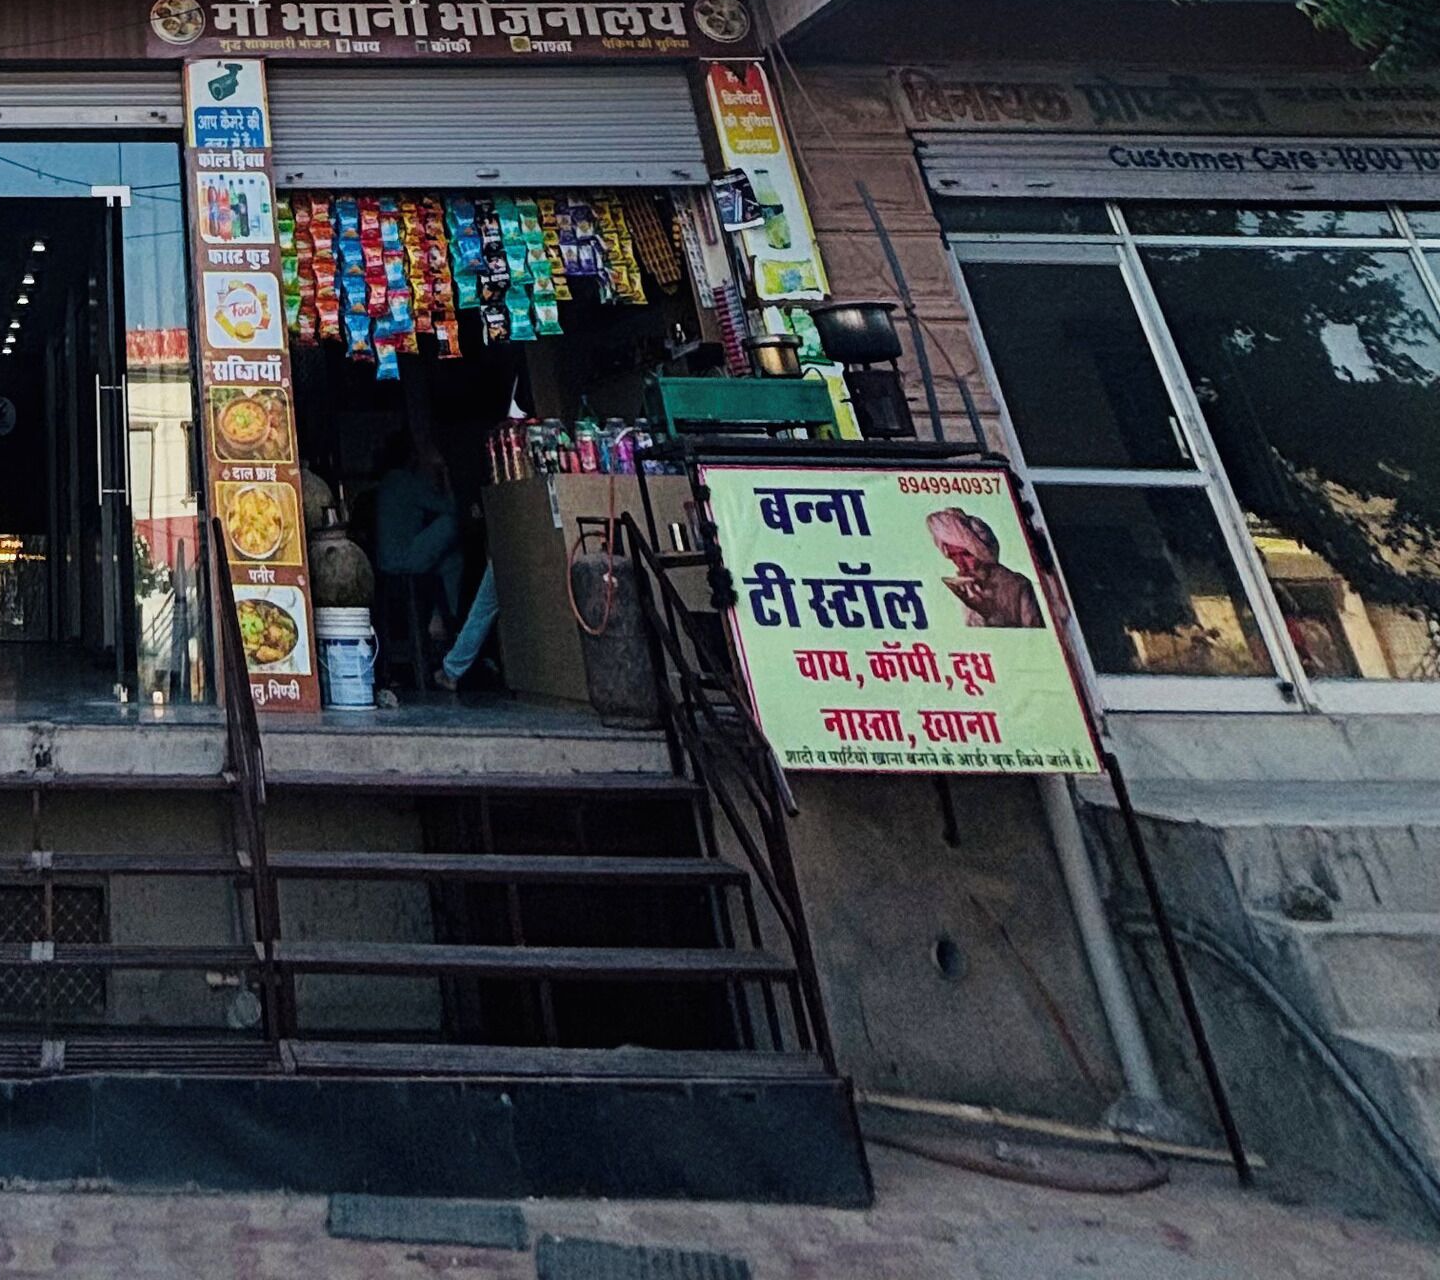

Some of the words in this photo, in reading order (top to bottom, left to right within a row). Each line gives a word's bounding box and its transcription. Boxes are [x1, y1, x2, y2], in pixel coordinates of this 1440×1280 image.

[351, 40, 381, 53] चाय
[198, 114, 218, 130] आप
[220, 109, 245, 130] कैमरे
[246, 109, 260, 130] की
[1108, 145, 1245, 172] Customer
[1251, 147, 1318, 172] Care
[228, 299, 257, 317] Food
[231, 466, 254, 481] दाल
[897, 476, 1002, 495] 8949940937
[754, 487, 872, 537] बन्ना
[248, 565, 276, 584] पनीर
[743, 562, 802, 628] टी
[802, 562, 930, 630] स्टॉल
[948, 652, 997, 697] दूध
[917, 710, 1002, 744] खाना
[786, 744, 813, 765] शादी
[871, 751, 902, 766] खाना
[906, 746, 939, 766] बनाने
[942, 746, 955, 766] के
